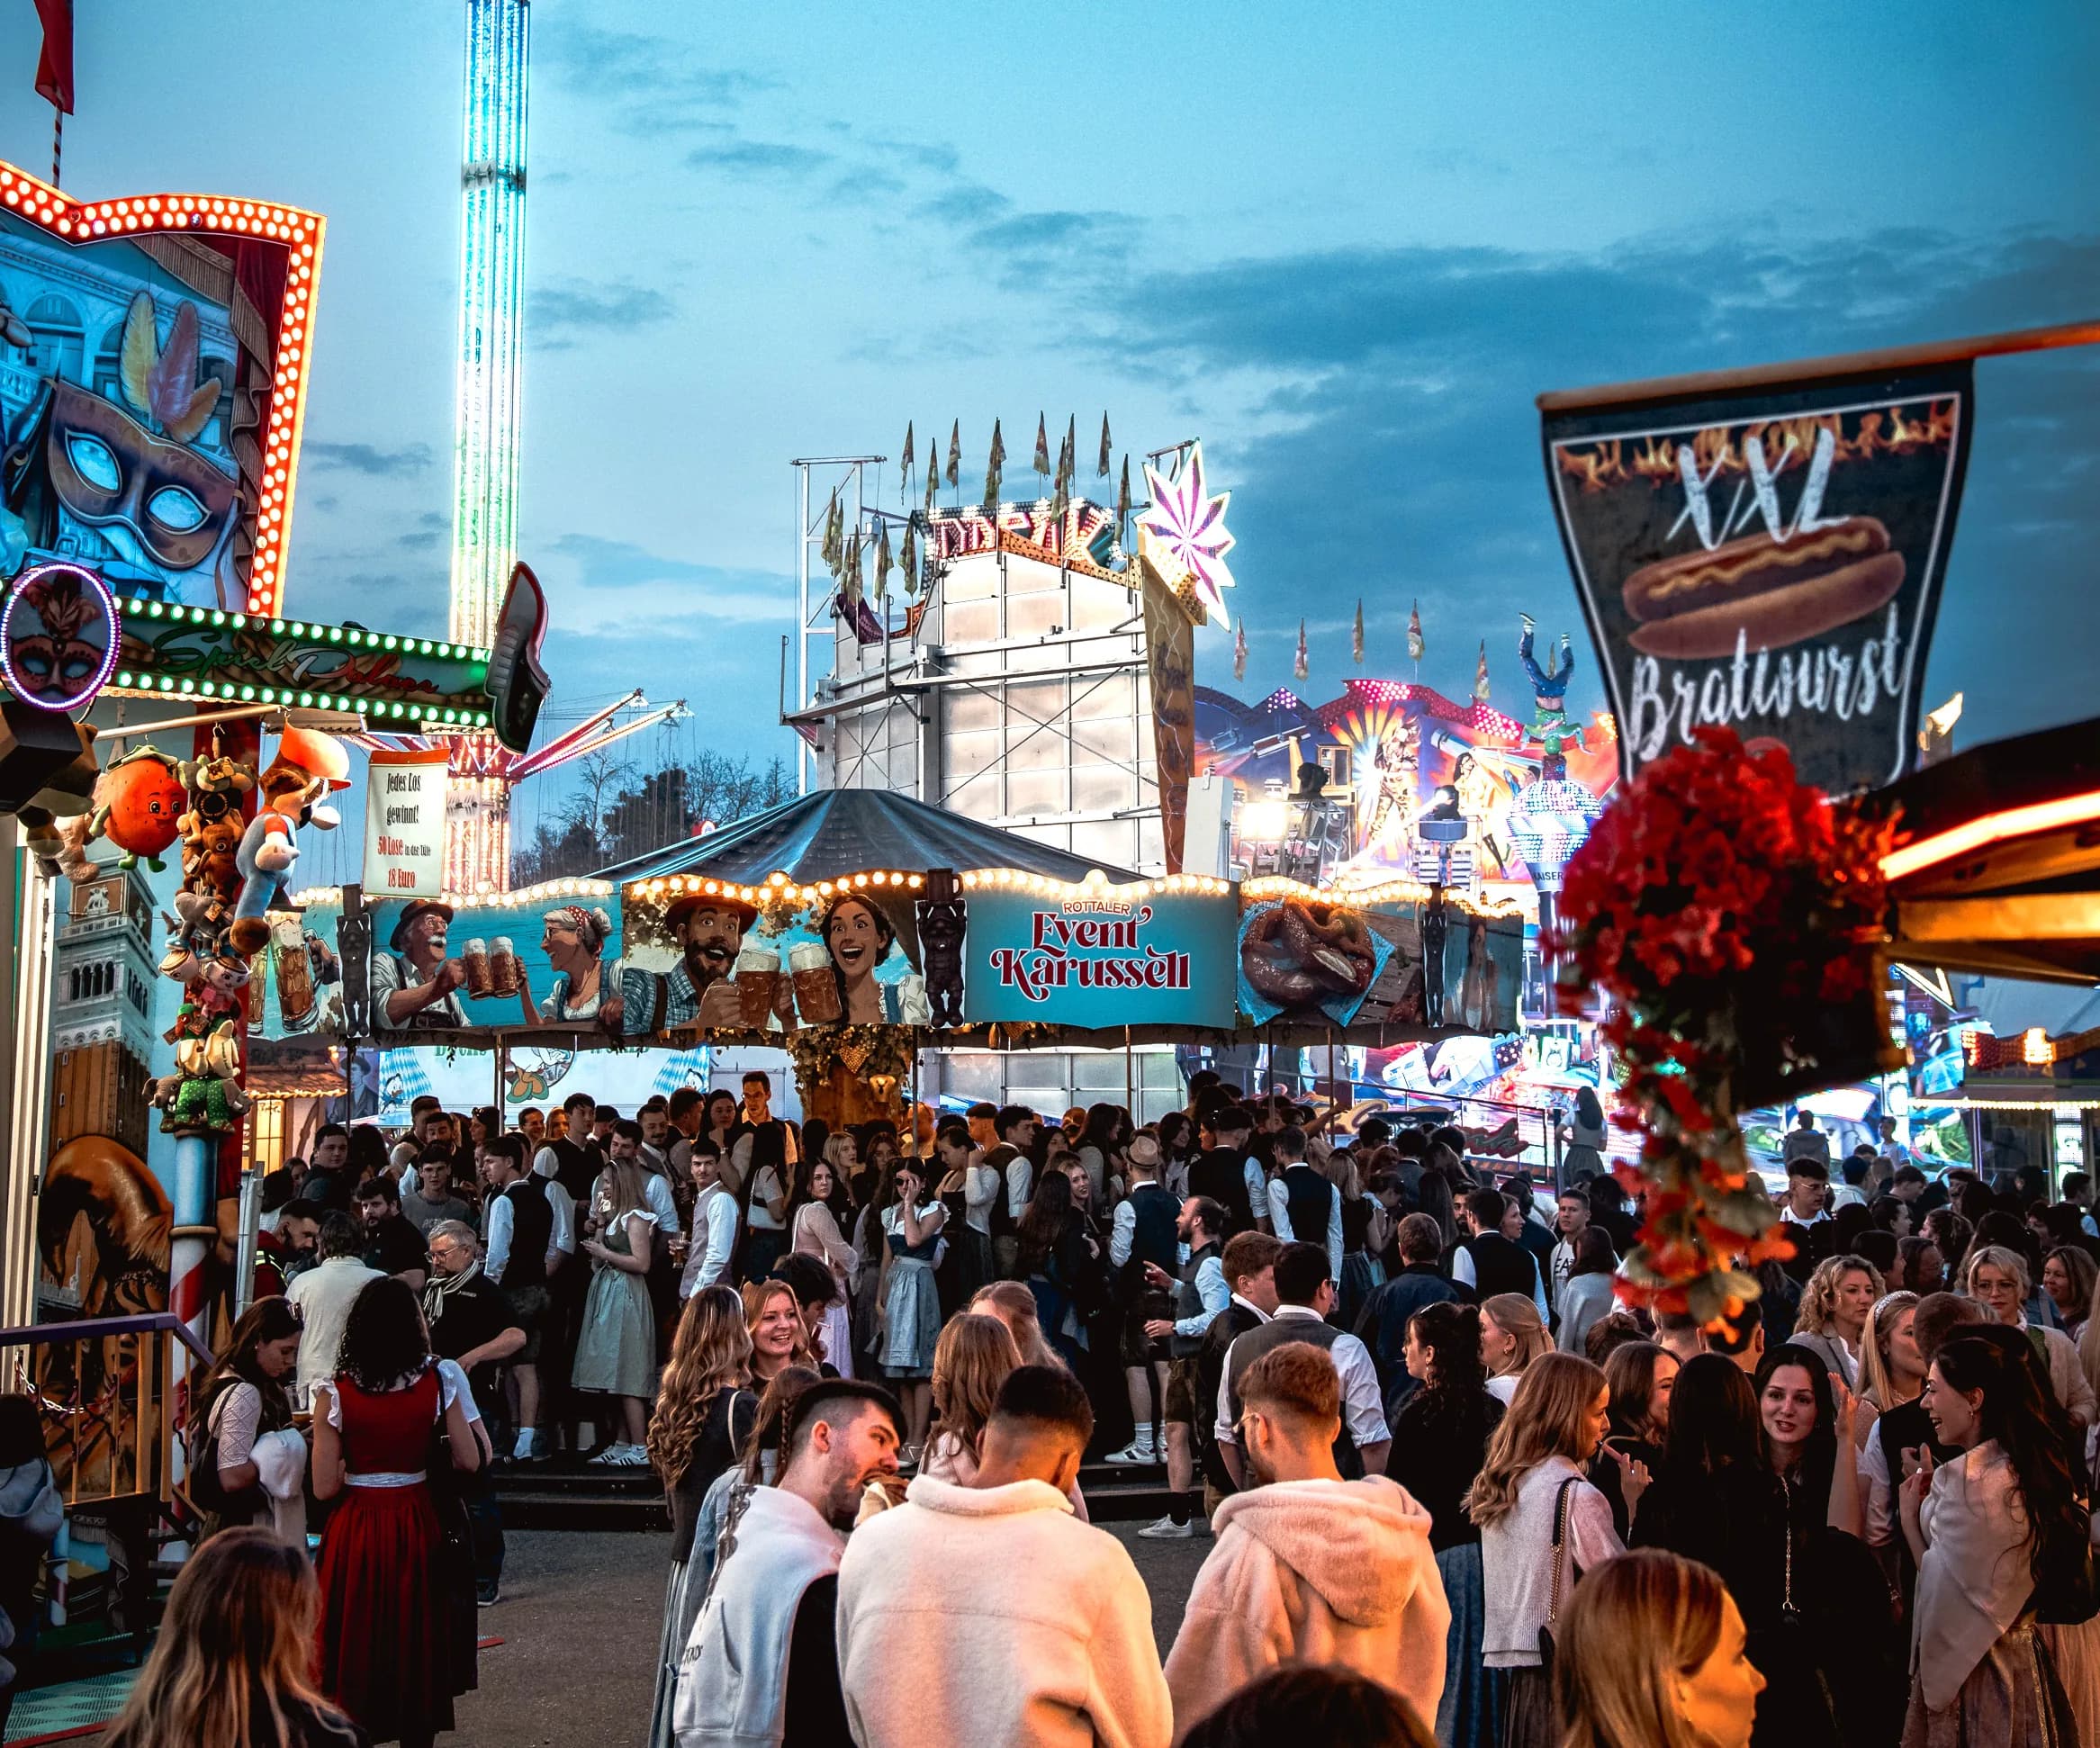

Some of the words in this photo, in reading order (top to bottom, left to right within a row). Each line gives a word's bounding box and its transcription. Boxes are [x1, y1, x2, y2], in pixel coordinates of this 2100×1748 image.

[1665, 428, 1851, 551] XXL
[1627, 600, 1913, 761] Bratwurst
[386, 773, 407, 794] Jedes
[408, 773, 421, 792] Los
[386, 804, 419, 826] gewinnt!
[377, 835, 387, 855] 50
[388, 836, 403, 856] Lose
[387, 868, 396, 888] 18
[398, 869, 416, 888] Euro
[1063, 902, 1131, 916] ROTTALER
[1032, 906, 1153, 958] Event
[989, 943, 1192, 1004] Karussell
